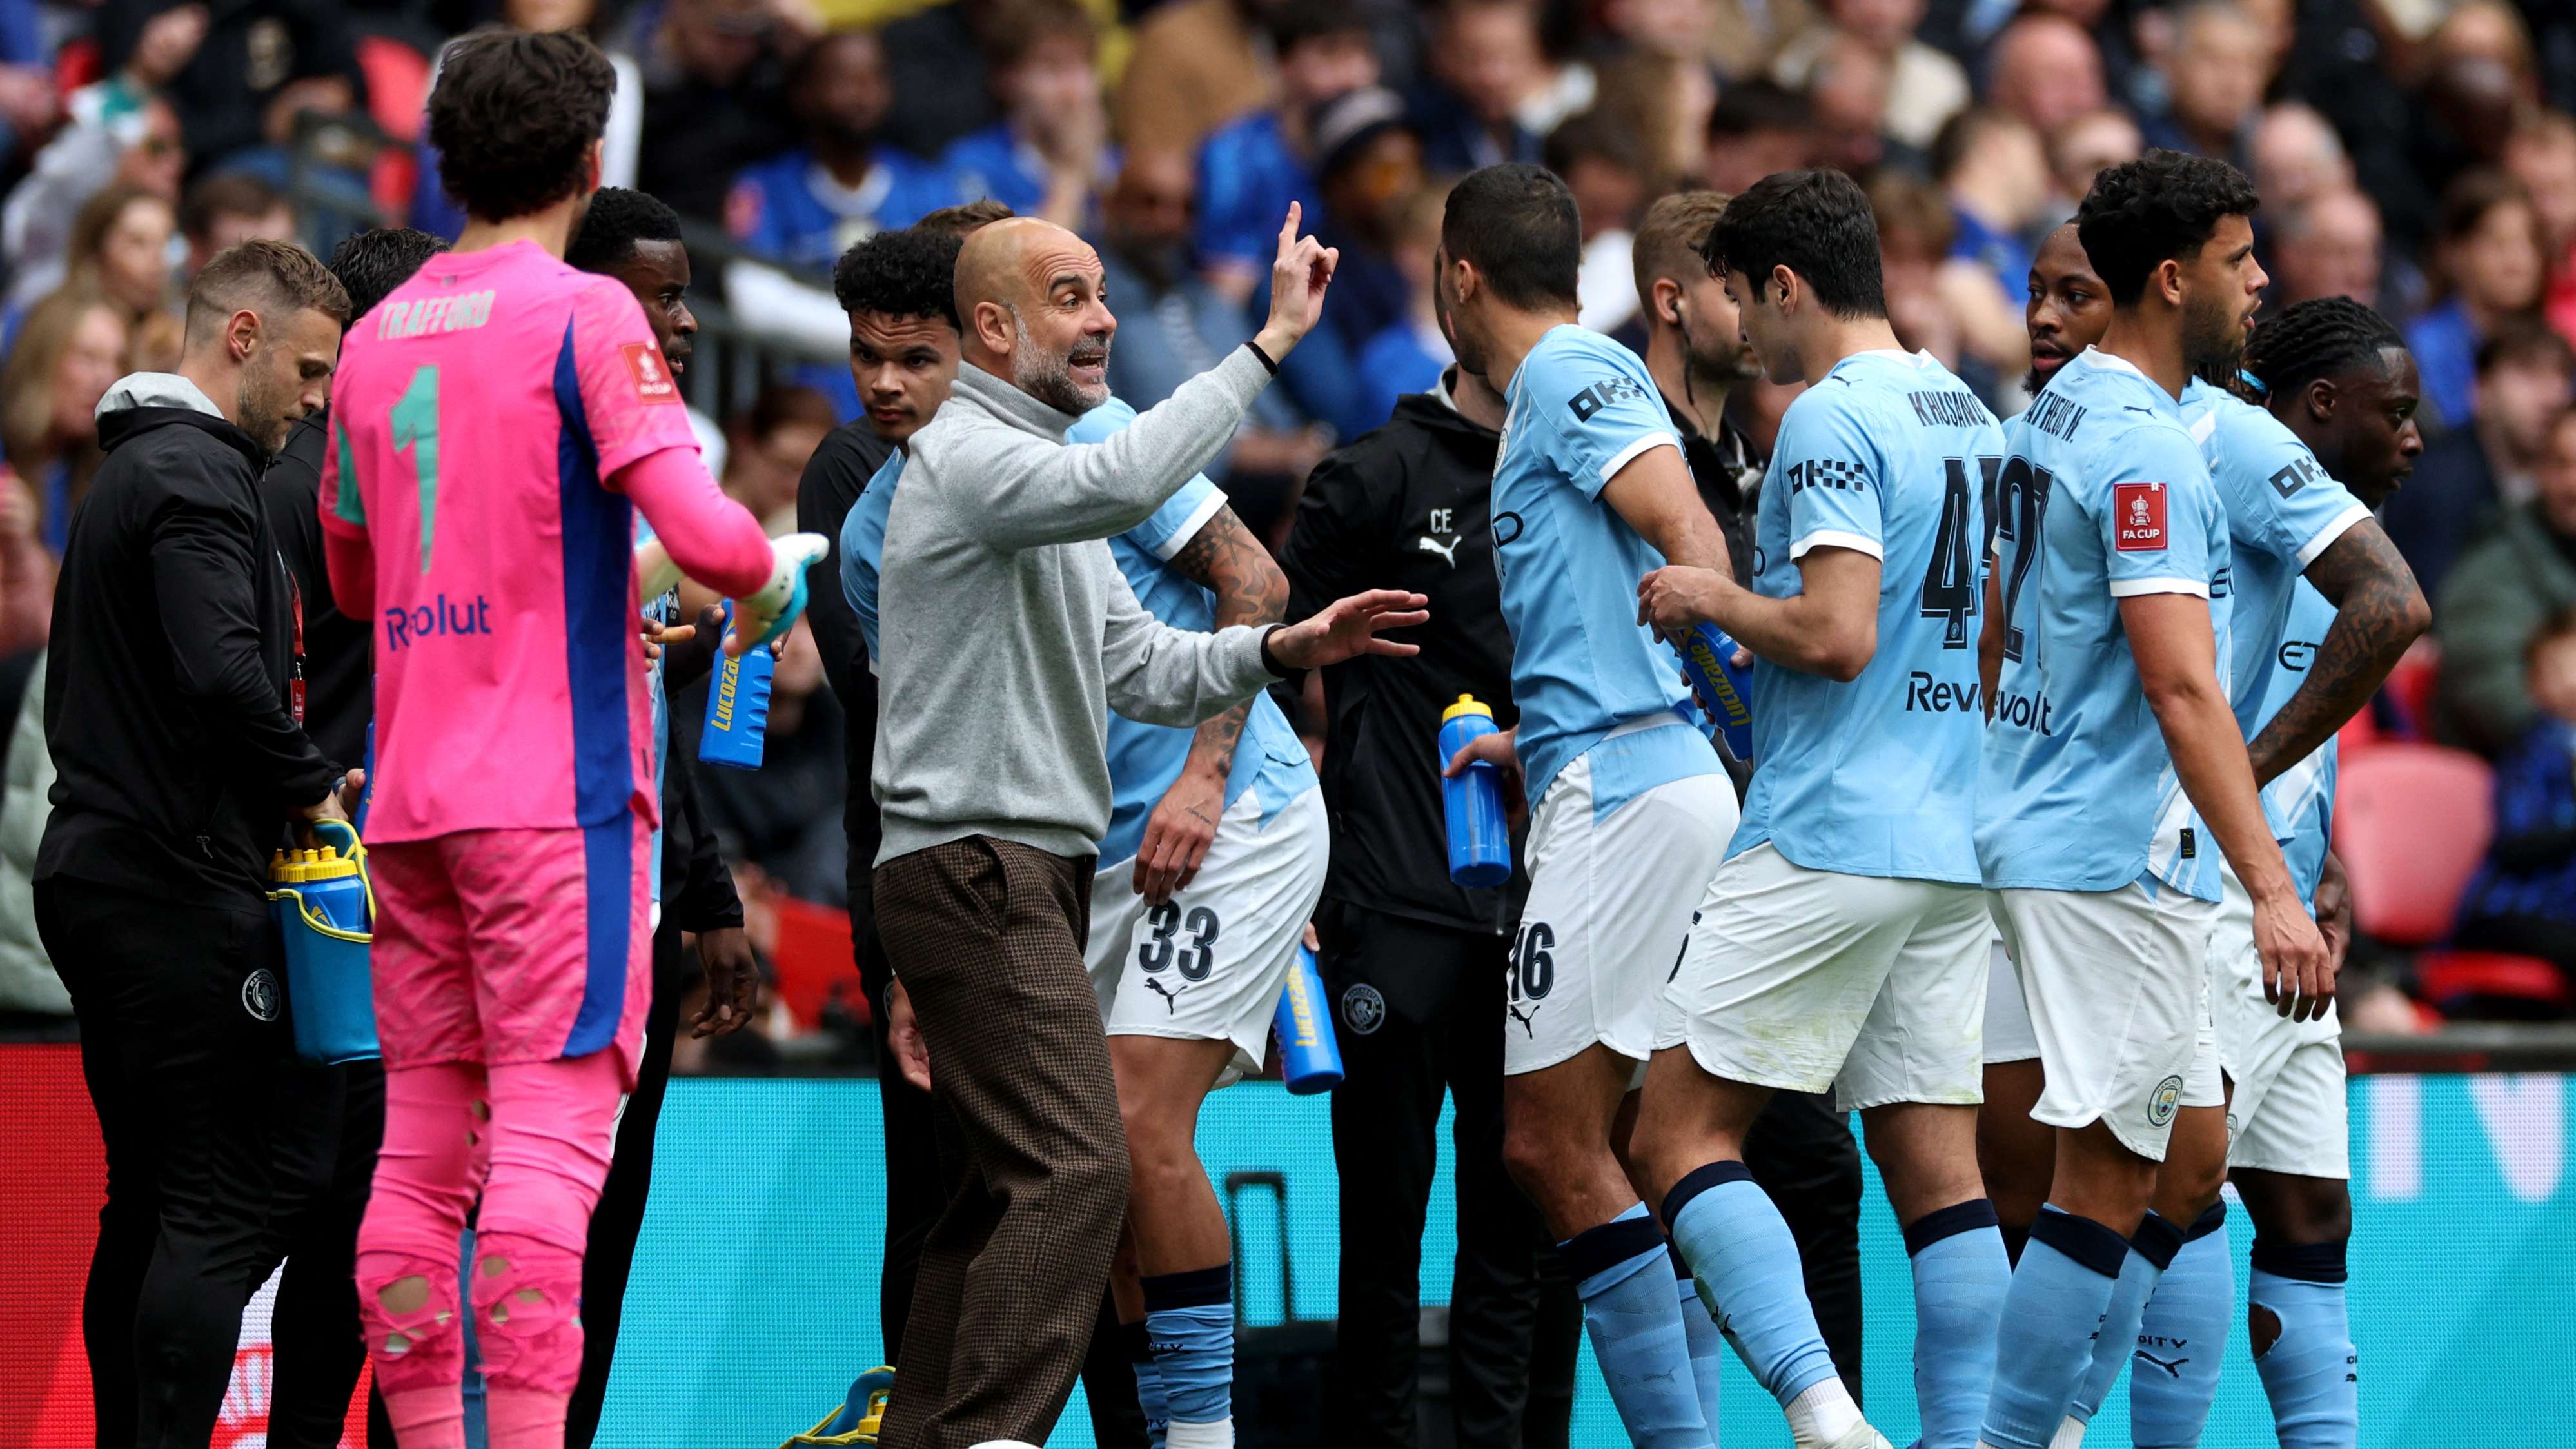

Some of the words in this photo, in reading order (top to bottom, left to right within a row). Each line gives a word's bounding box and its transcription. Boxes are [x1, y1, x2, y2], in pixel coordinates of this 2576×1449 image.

[378, 290, 495, 340] TRAFFORD
[2020, 389, 2076, 437] ATHEUS
[390, 363, 440, 574] 1
[1431, 508, 1453, 533] CE
[2123, 529, 2136, 539] FA
[2137, 529, 2160, 539] CUP
[386, 593, 492, 651] Rolut
[711, 655, 740, 732] Lucoza
[1690, 641, 1752, 727] Lucozade
[1139, 898, 1221, 982] 33
[1511, 921, 1555, 1002] 16
